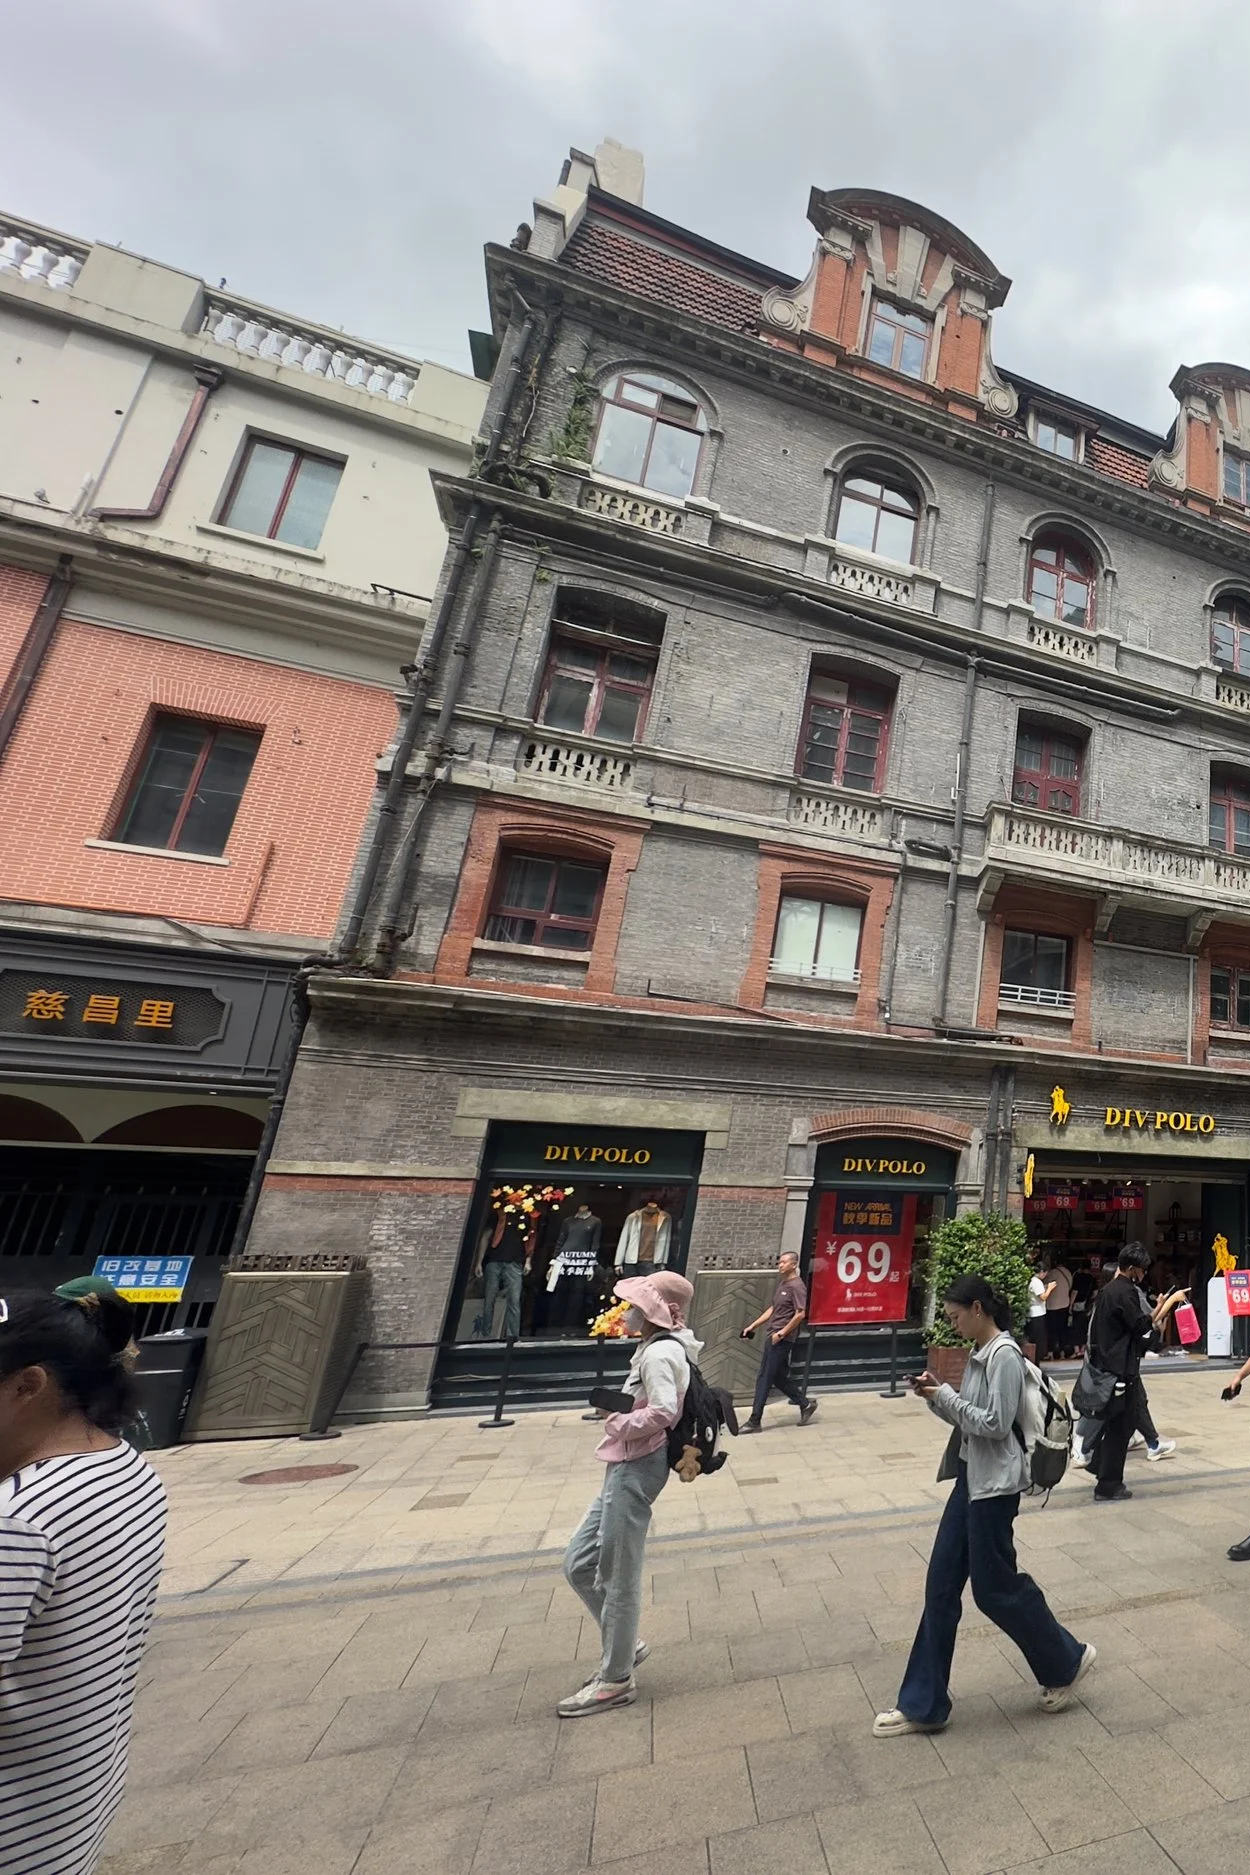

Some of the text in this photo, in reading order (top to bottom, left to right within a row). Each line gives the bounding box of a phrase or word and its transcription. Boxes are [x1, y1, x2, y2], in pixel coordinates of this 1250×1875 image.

[22, 989, 175, 1028] 慈昌里
[544, 1145, 651, 1165] DIV.POLO
[843, 1158, 926, 1175] DIV.POLO
[842, 1212, 893, 1226] 秋季新品
[559, 1251, 597, 1259] AUTUMN
[101, 1260, 184, 1273] 旧改基地
